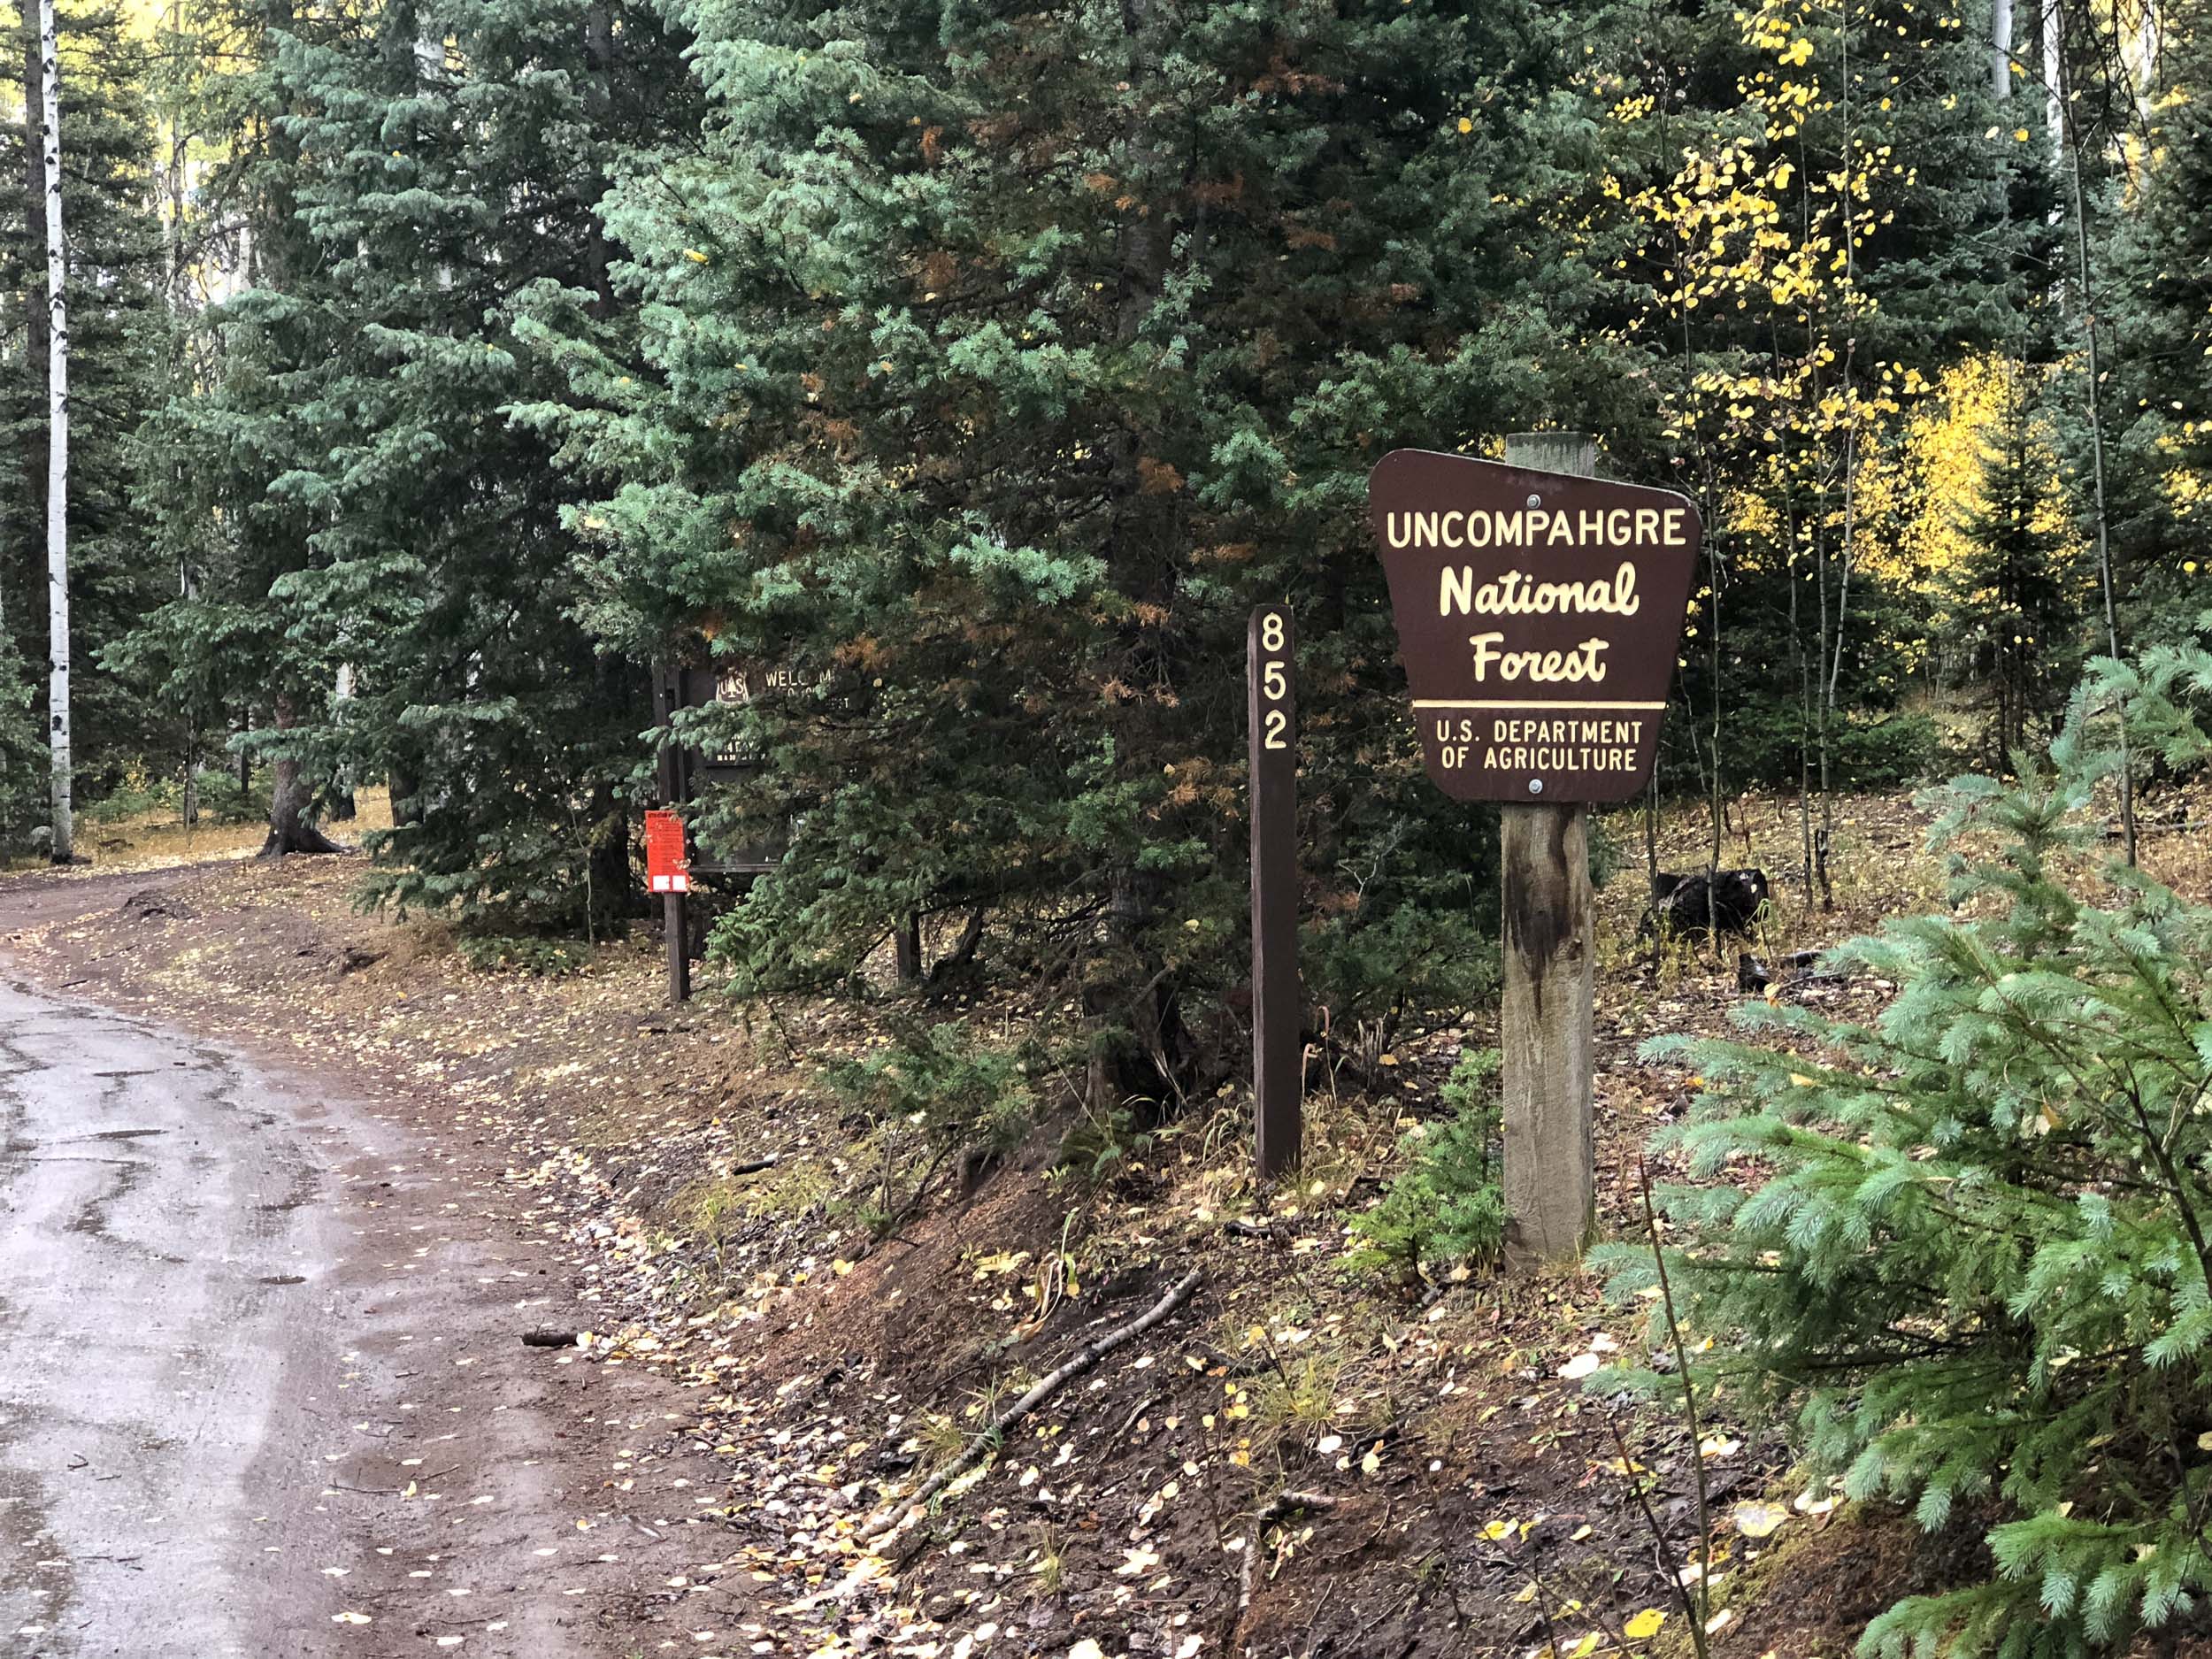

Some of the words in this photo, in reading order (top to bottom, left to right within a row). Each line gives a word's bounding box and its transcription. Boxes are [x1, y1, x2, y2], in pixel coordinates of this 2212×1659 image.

[1386, 508, 1686, 549] UNCOMPAHGRE
[1440, 561, 1640, 617] National
[1469, 632, 1609, 682] Forest
[1436, 719, 1480, 743] U.S.
[1494, 719, 1643, 744] DEPARTMENT
[1441, 745, 1470, 769] OF
[1484, 746, 1637, 772] AGRICULTURE
